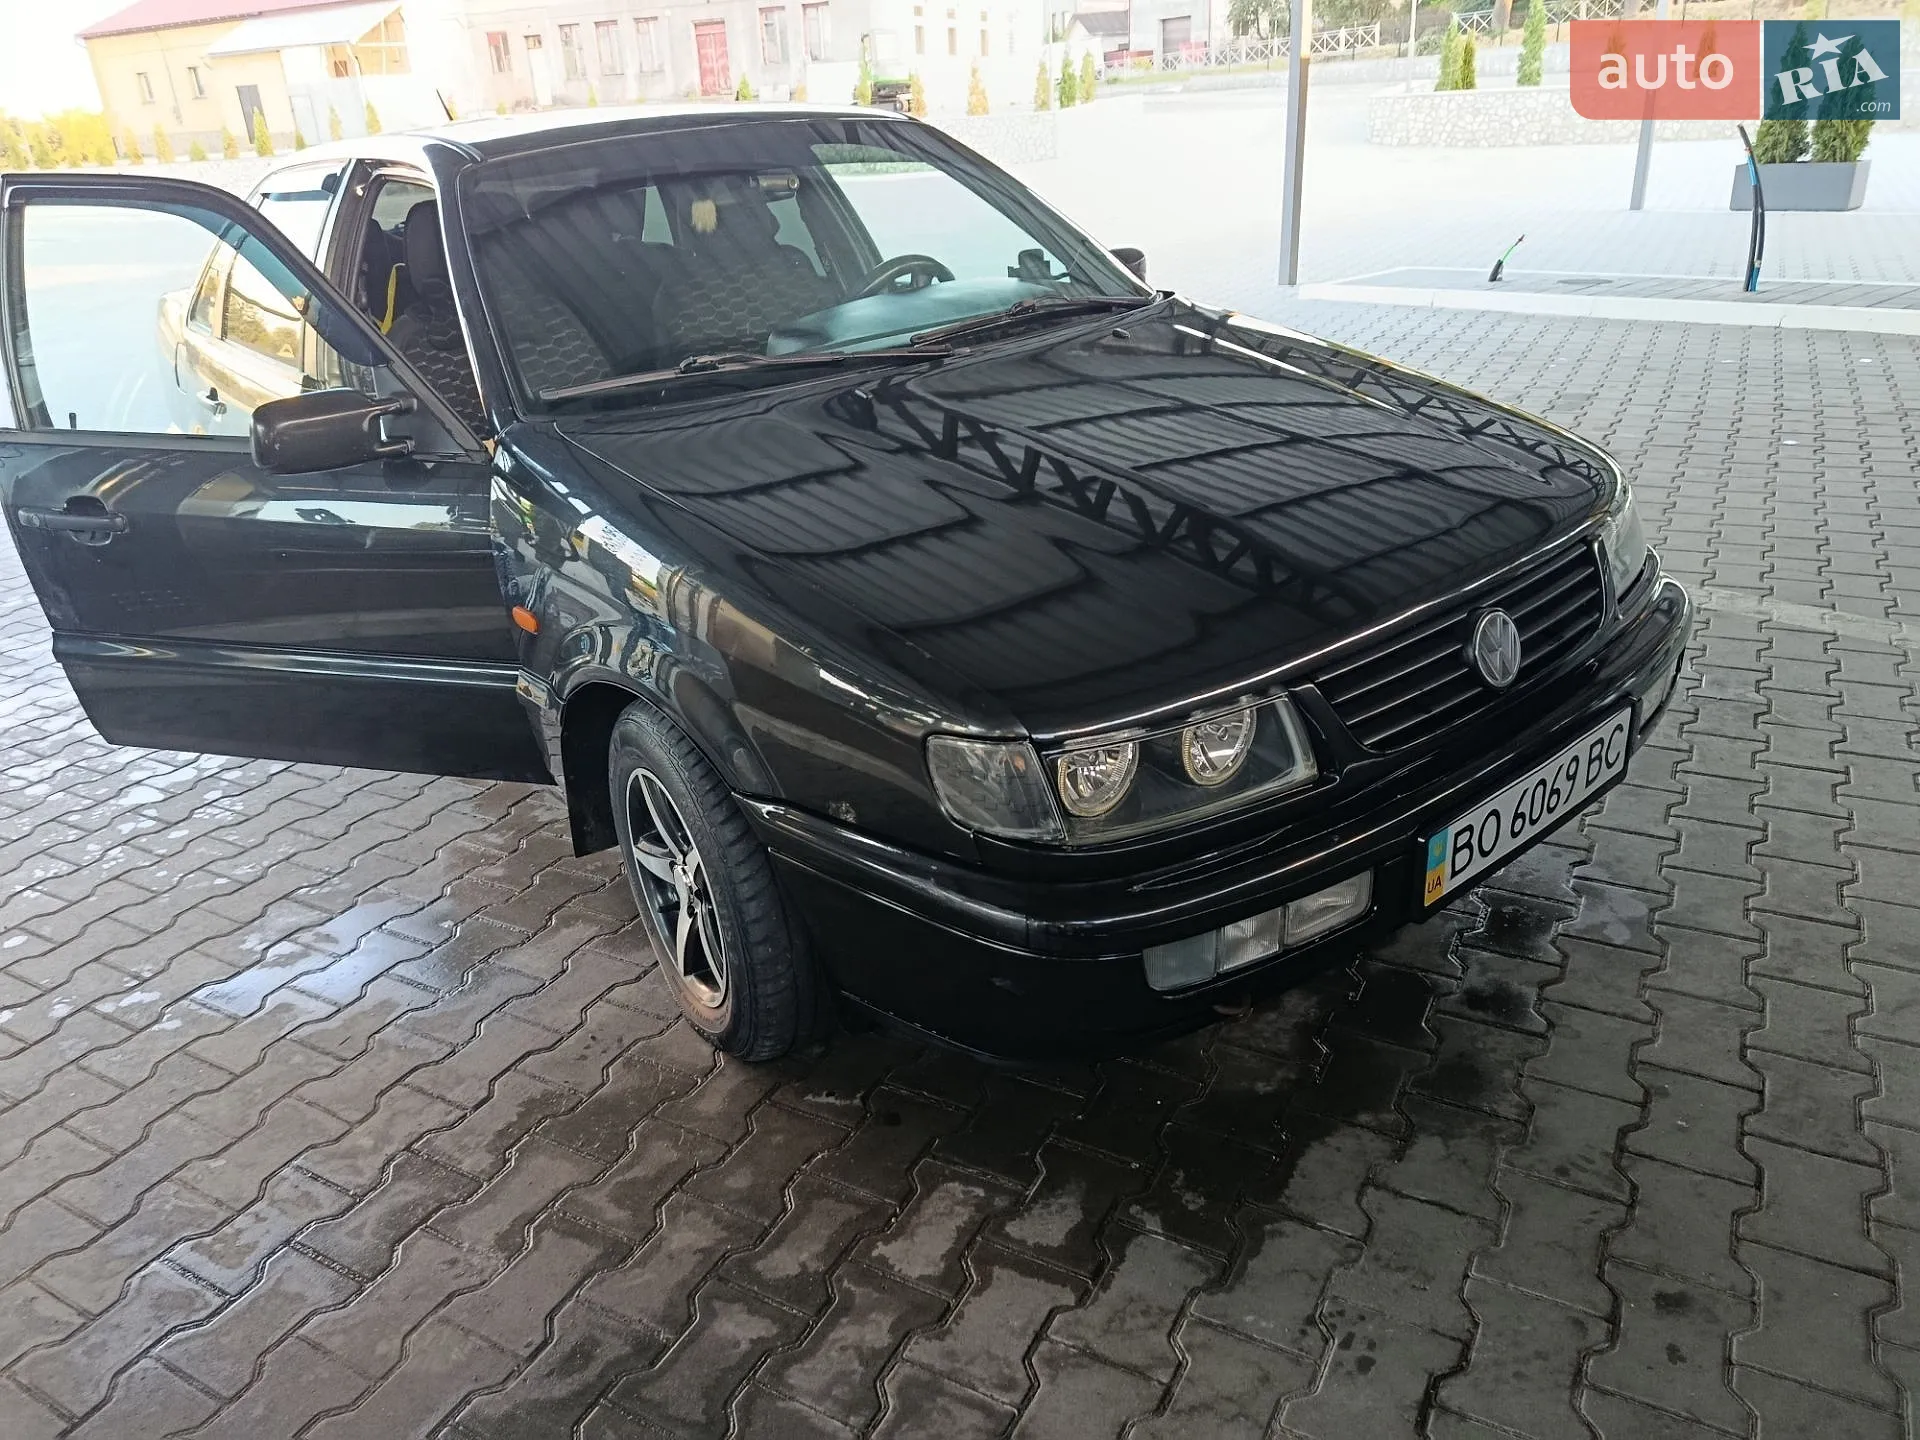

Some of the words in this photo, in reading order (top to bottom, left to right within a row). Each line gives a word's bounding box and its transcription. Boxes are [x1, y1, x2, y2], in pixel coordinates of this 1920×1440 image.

[1450, 809, 1501, 880] BO
[1510, 755, 1580, 839] 6069
[1585, 723, 1624, 789] BC
[1427, 876, 1442, 894] UA
